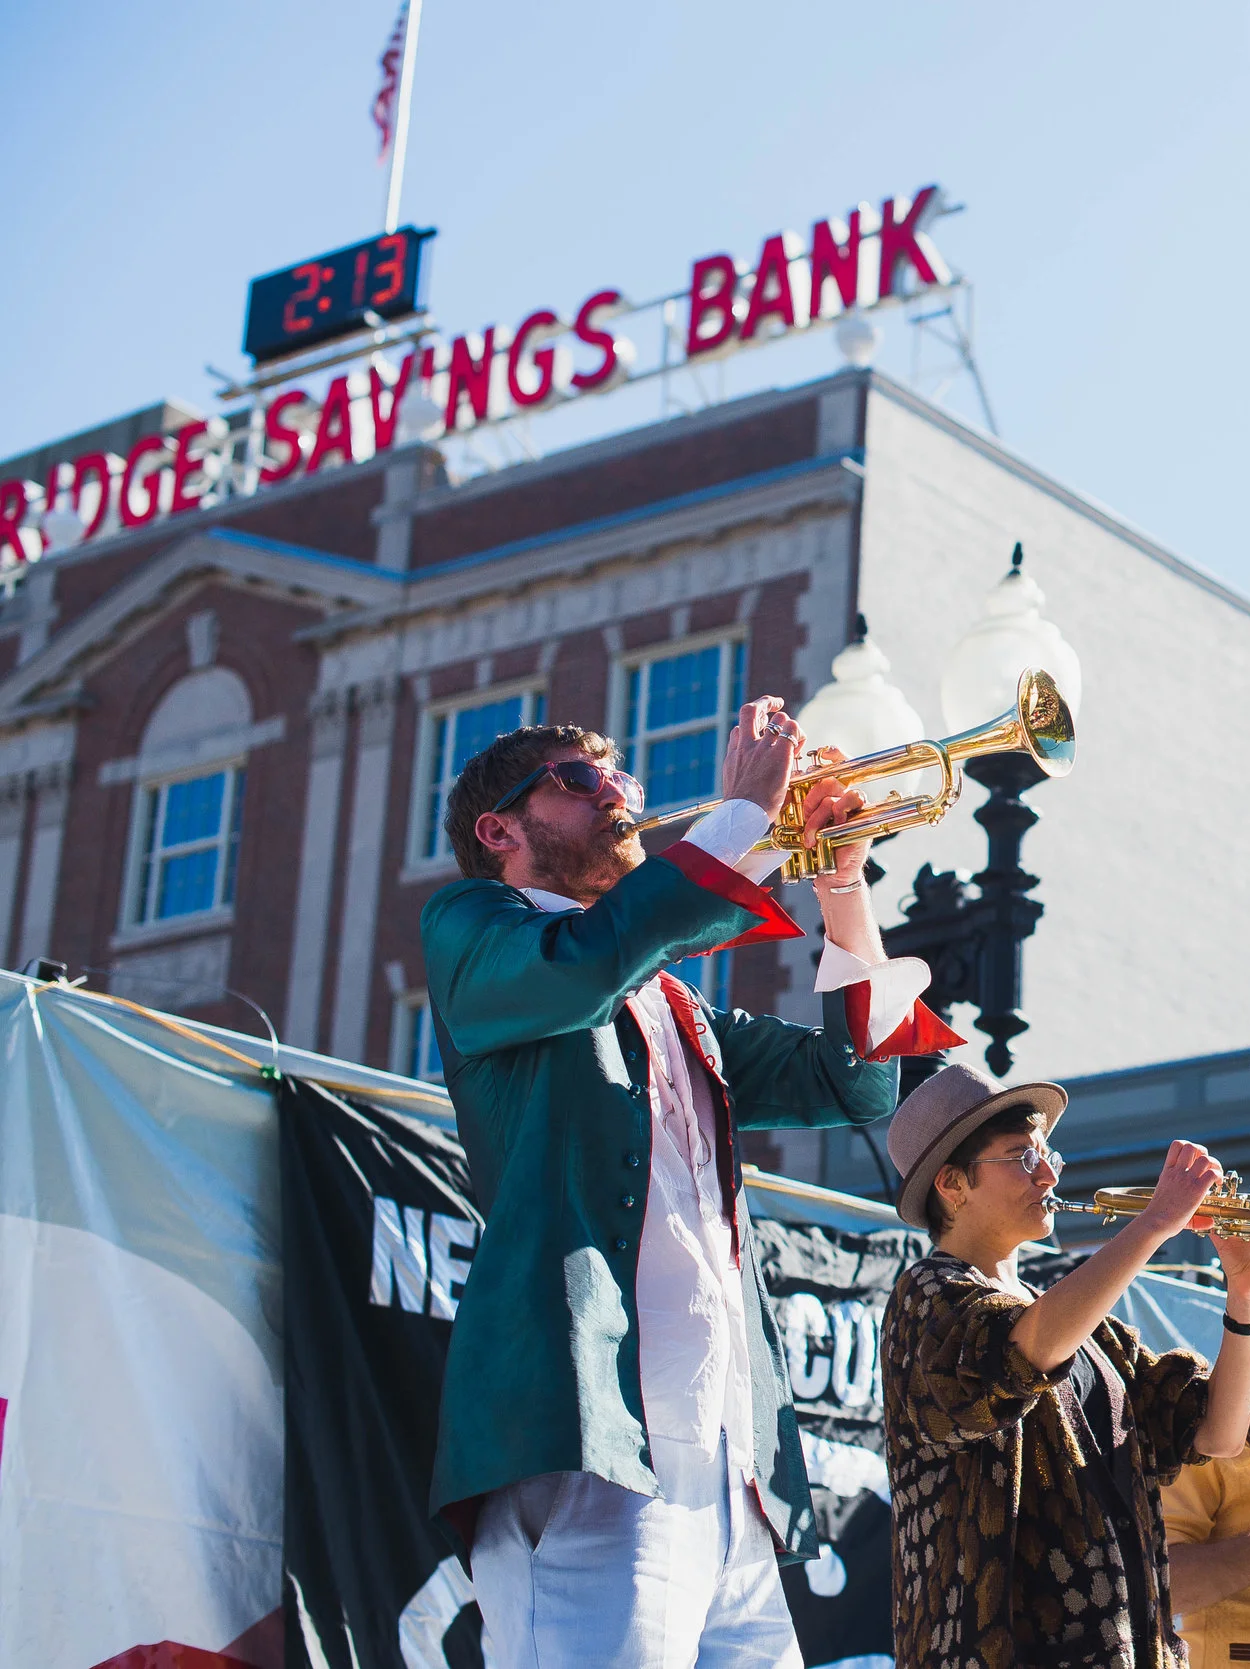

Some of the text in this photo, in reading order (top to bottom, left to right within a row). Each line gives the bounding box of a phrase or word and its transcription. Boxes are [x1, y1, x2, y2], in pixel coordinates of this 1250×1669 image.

[283, 233, 408, 333] 2:13
[686, 184, 940, 357] BANK
[786, 1291, 884, 1408] CO
